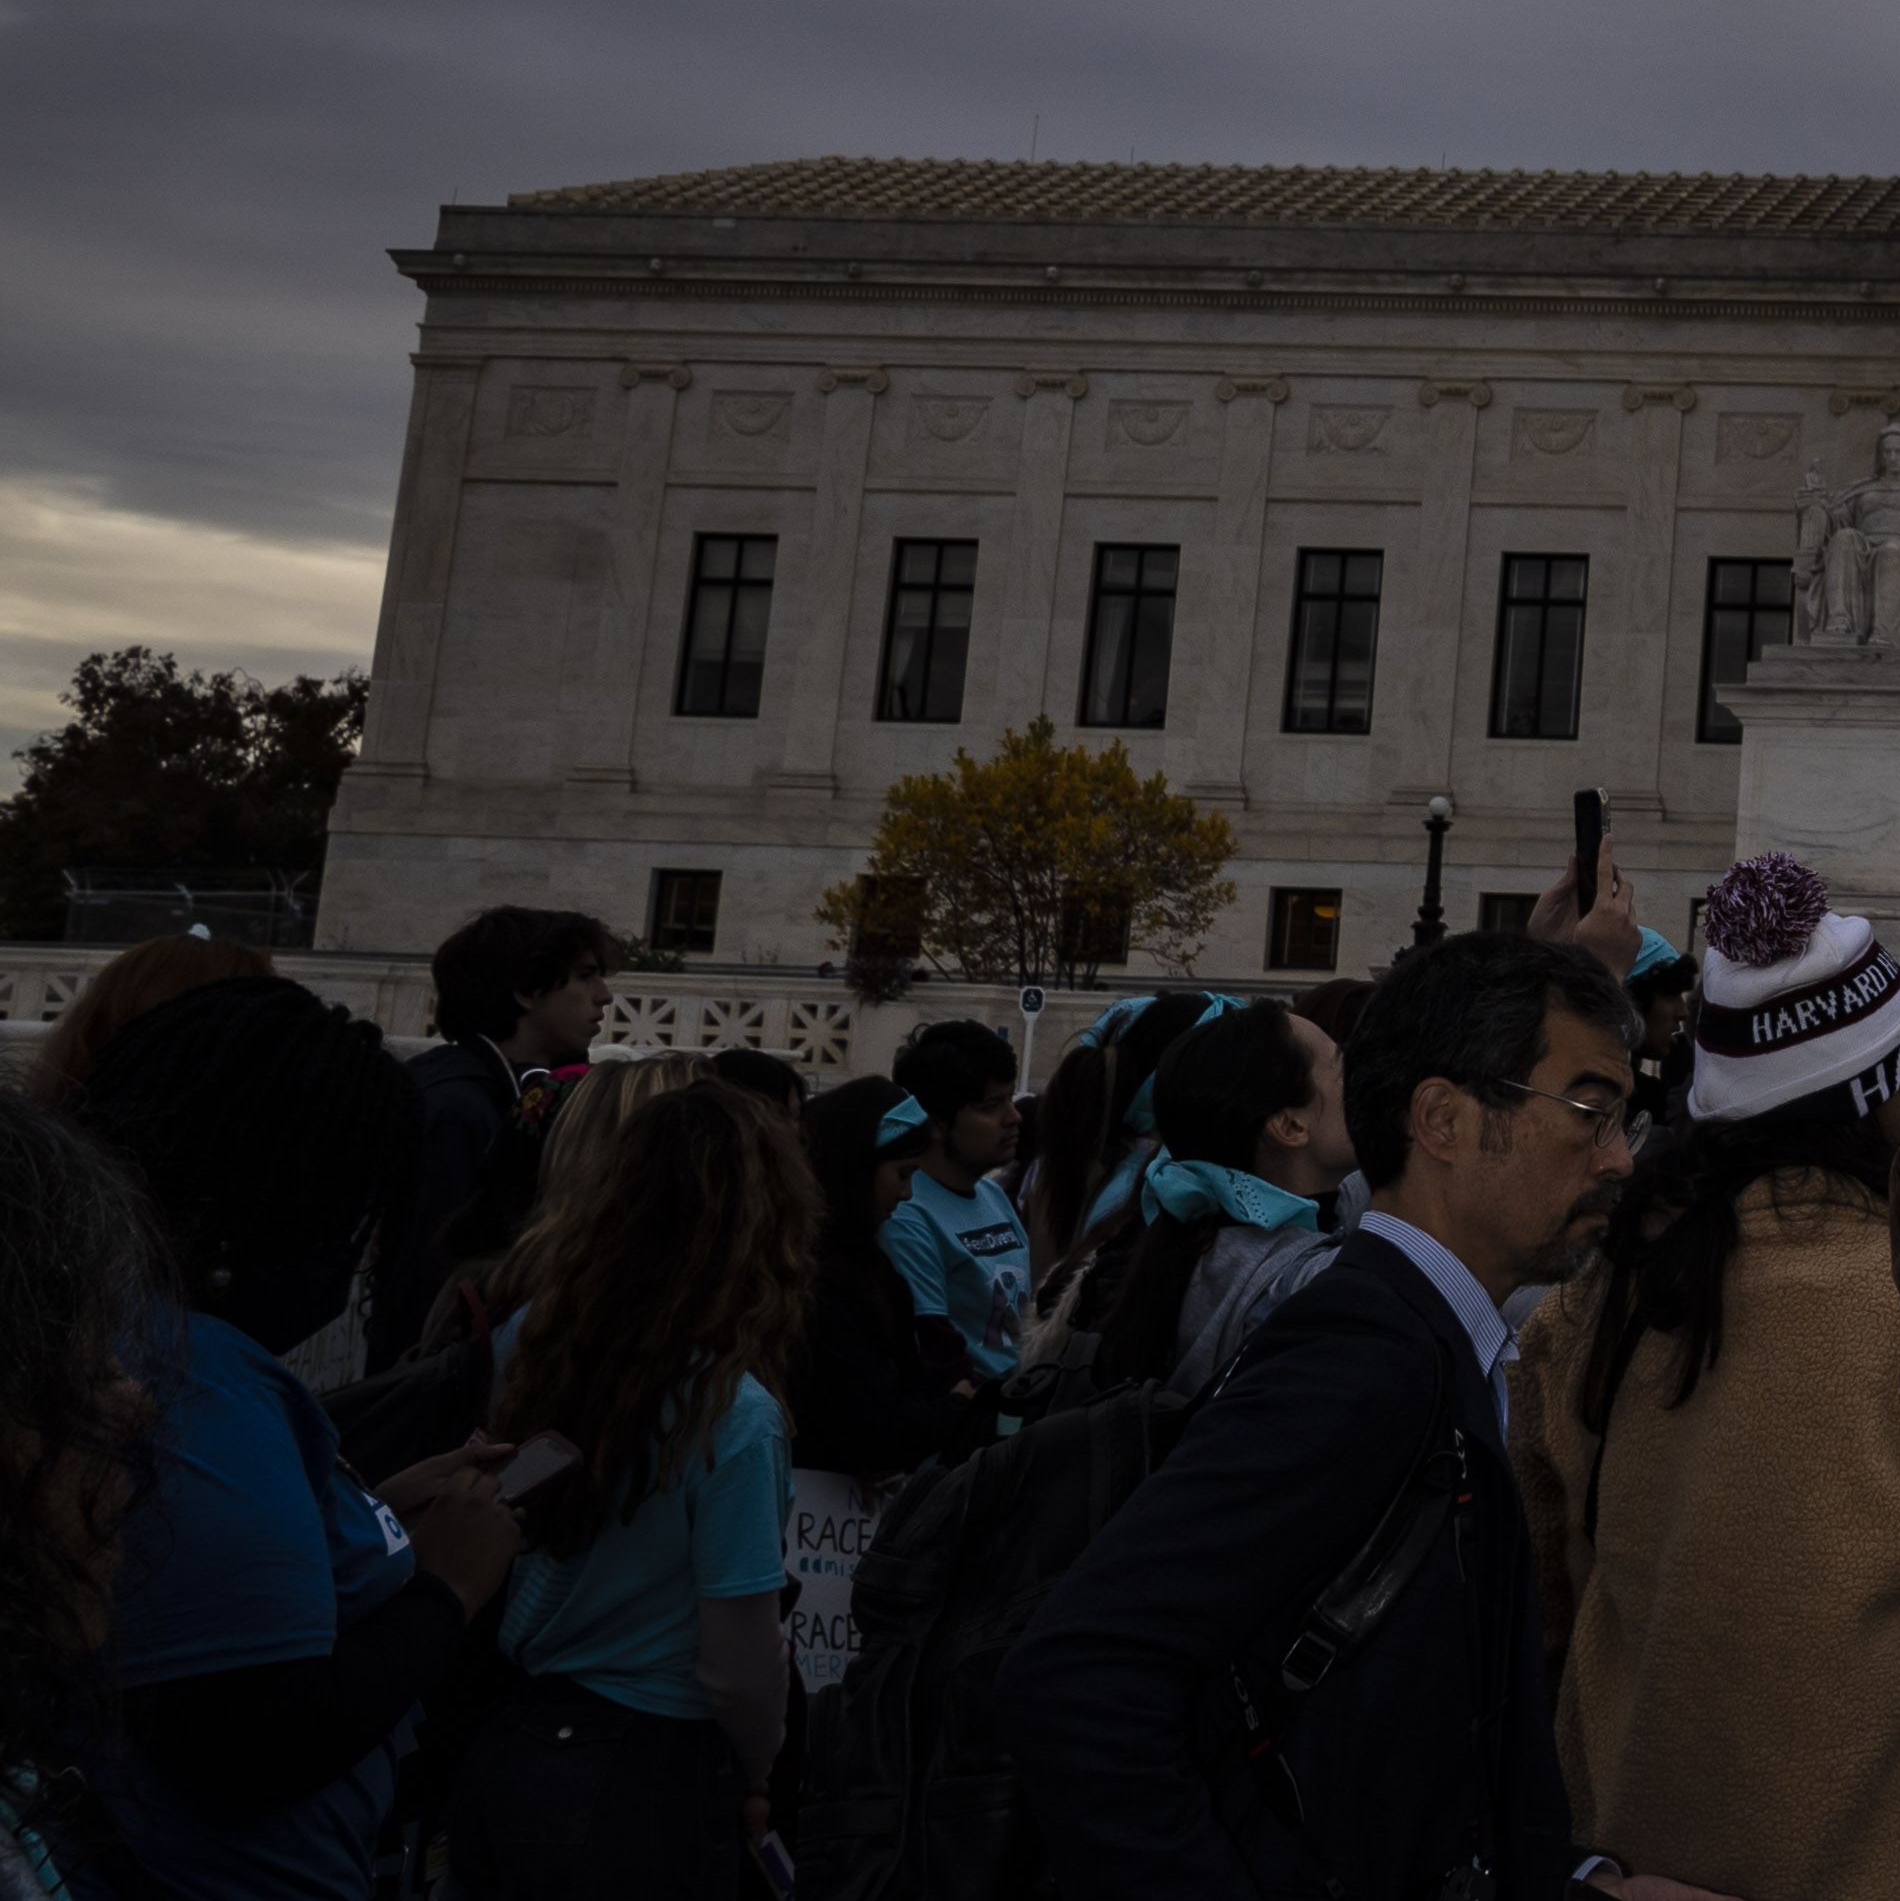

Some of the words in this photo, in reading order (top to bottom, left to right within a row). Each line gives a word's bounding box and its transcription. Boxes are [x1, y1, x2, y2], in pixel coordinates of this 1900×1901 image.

[1751, 963, 1889, 1045] HARVARD
[798, 1512, 872, 1556] RACE
[790, 1610, 863, 1653] RACE
